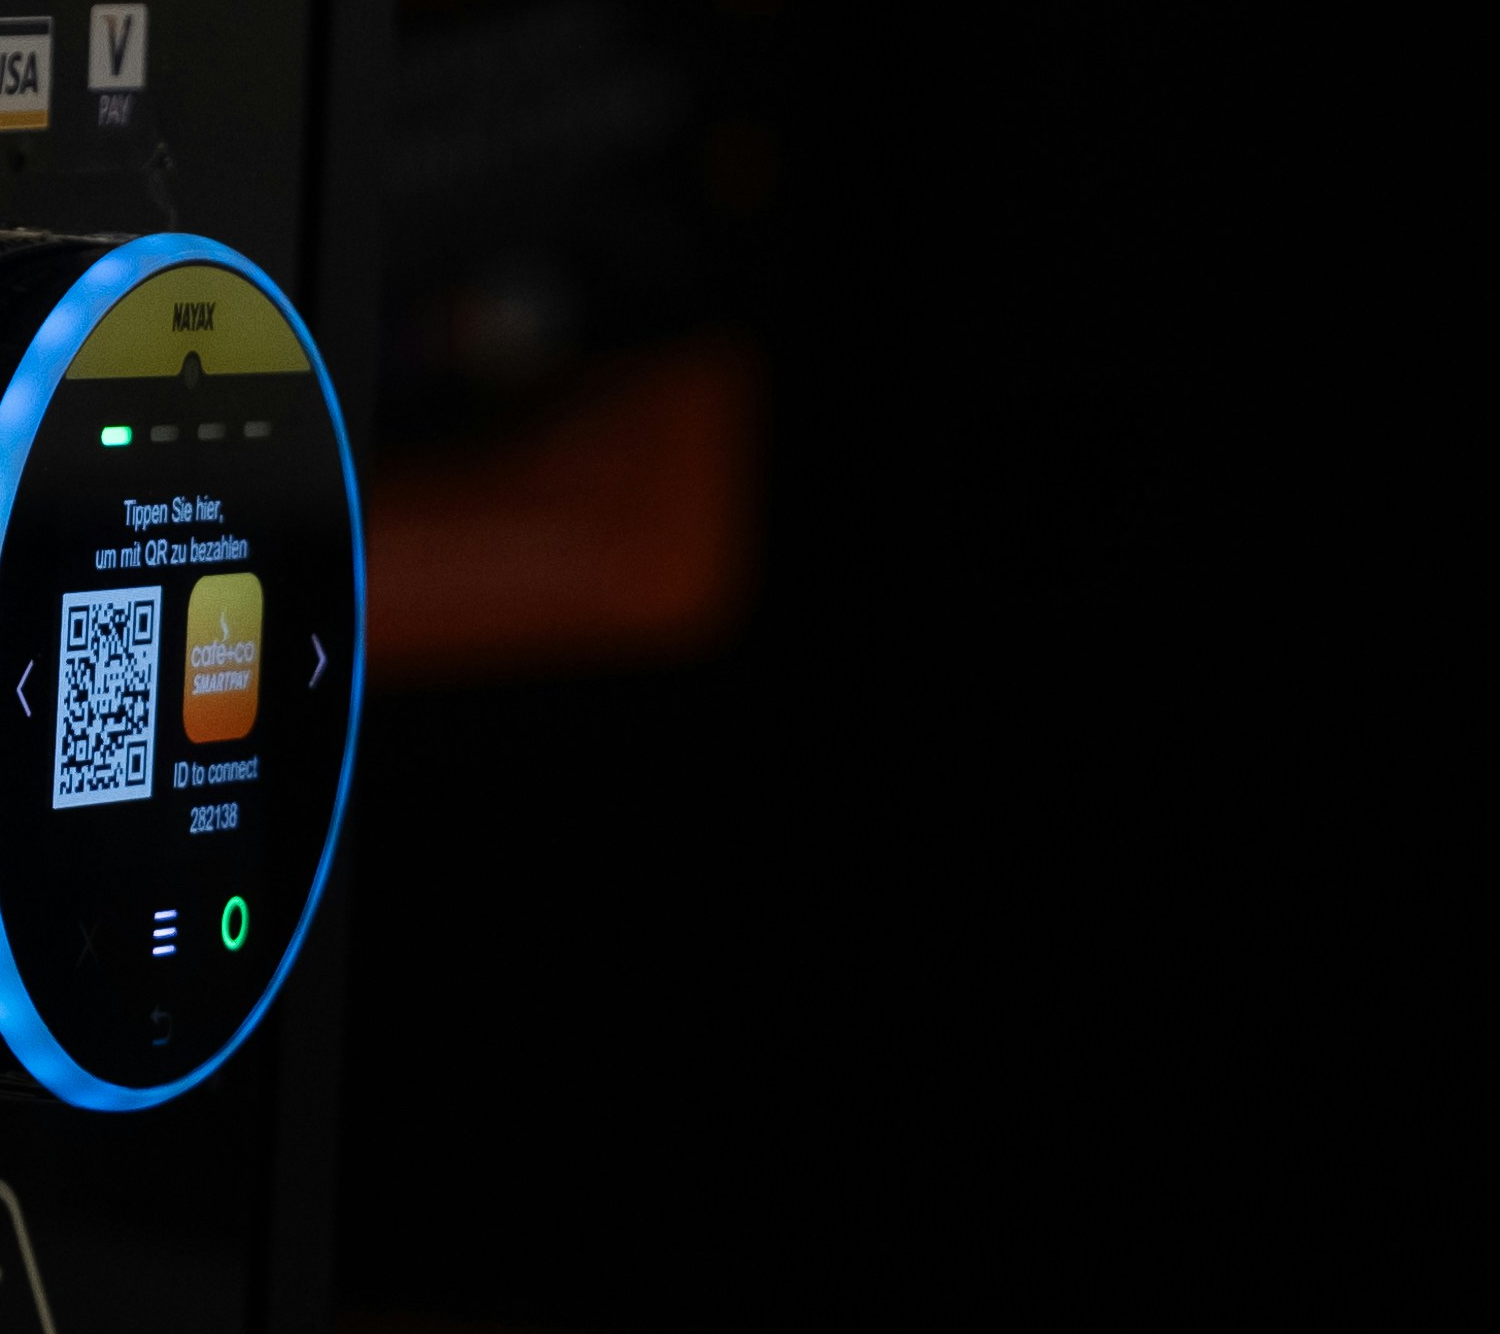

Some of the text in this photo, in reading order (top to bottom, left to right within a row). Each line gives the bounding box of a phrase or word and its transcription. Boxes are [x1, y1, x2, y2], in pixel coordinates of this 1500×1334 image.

[172, 302, 215, 331] NAYAX
[124, 495, 223, 531] Tippen Sie hier,
[95, 534, 249, 570] um mit QR zu bezahlen
[173, 756, 261, 788] ID to connect
[189, 802, 240, 835] 282138
